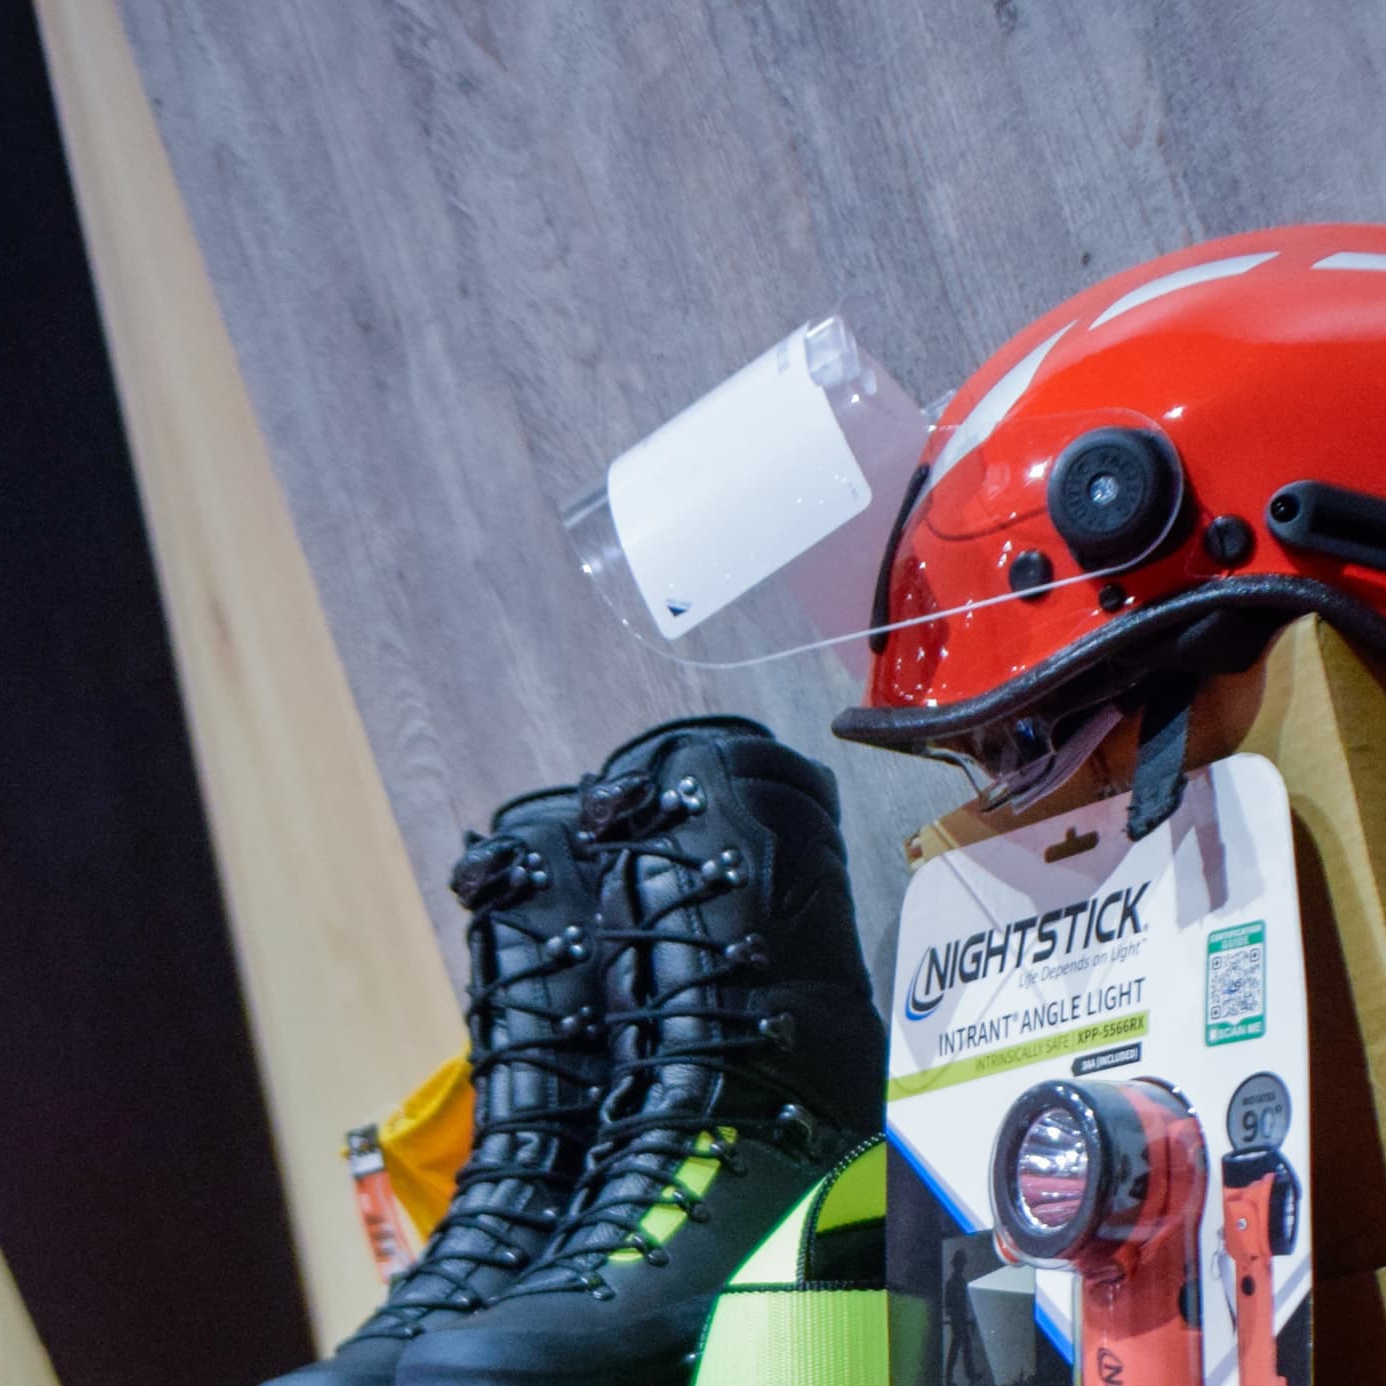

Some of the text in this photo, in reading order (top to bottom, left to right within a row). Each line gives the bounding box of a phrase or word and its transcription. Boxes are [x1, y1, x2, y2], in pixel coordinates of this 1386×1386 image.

[923, 880, 1152, 997] NIGHTSTICK
[1018, 968, 1038, 989] Life
[1041, 955, 1090, 981] Depends
[1093, 951, 1107, 967] on
[1020, 994, 1083, 1035] ANGLE
[1087, 976, 1147, 1017] LIGHT
[974, 1015, 1145, 1072] INTRINSICALLY SAFE XPP-5566RX
